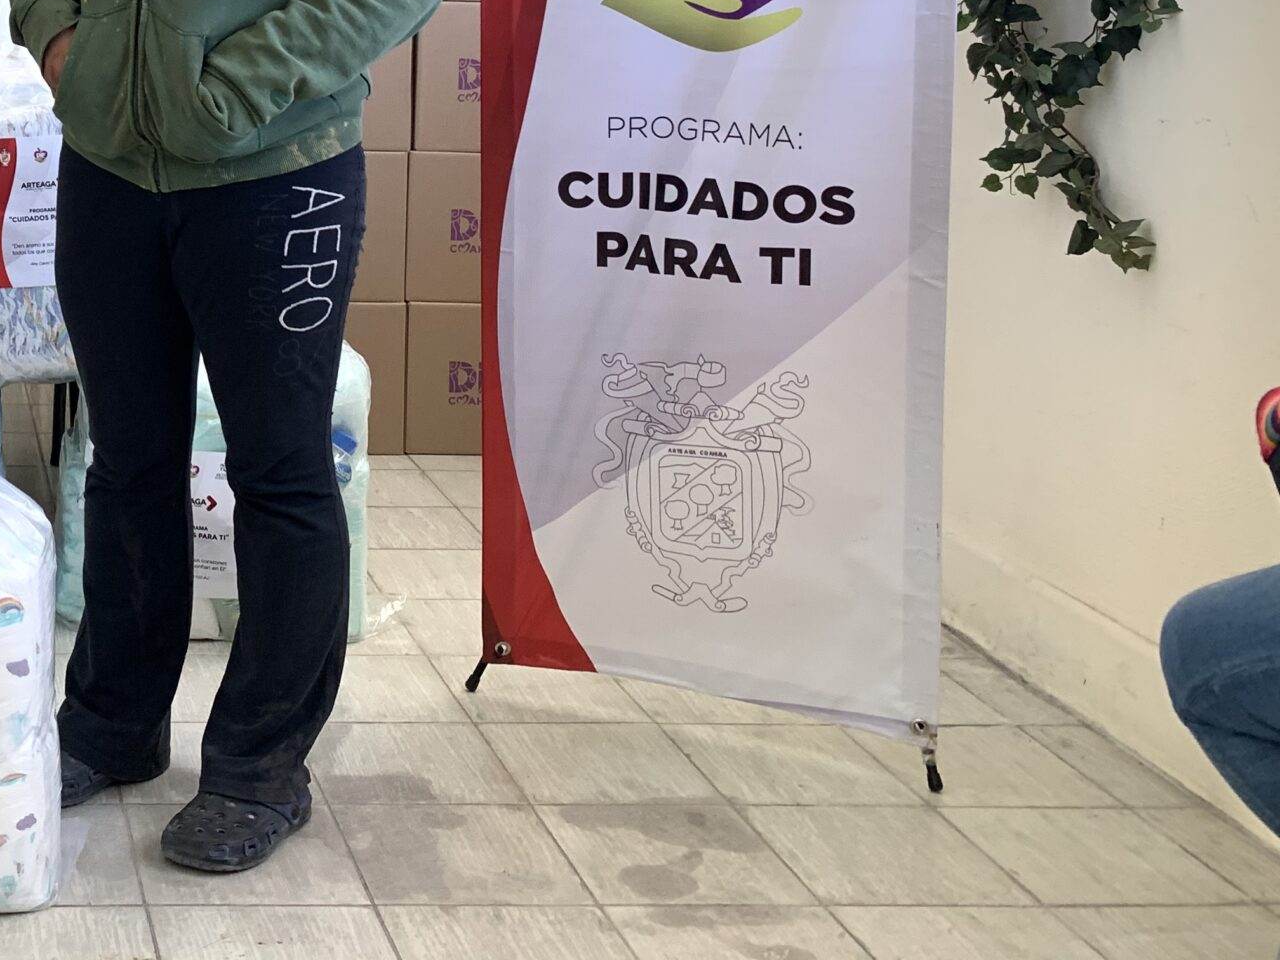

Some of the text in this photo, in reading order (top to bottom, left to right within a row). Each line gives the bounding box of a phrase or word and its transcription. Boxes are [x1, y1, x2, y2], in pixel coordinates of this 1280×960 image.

[607, 115, 804, 150] PROGRAMA:
[21, 181, 57, 189] ARTEAGA
[558, 171, 856, 225] CUIDADOS
[278, 185, 345, 332] AERO
[596, 231, 812, 286] PARA TI
